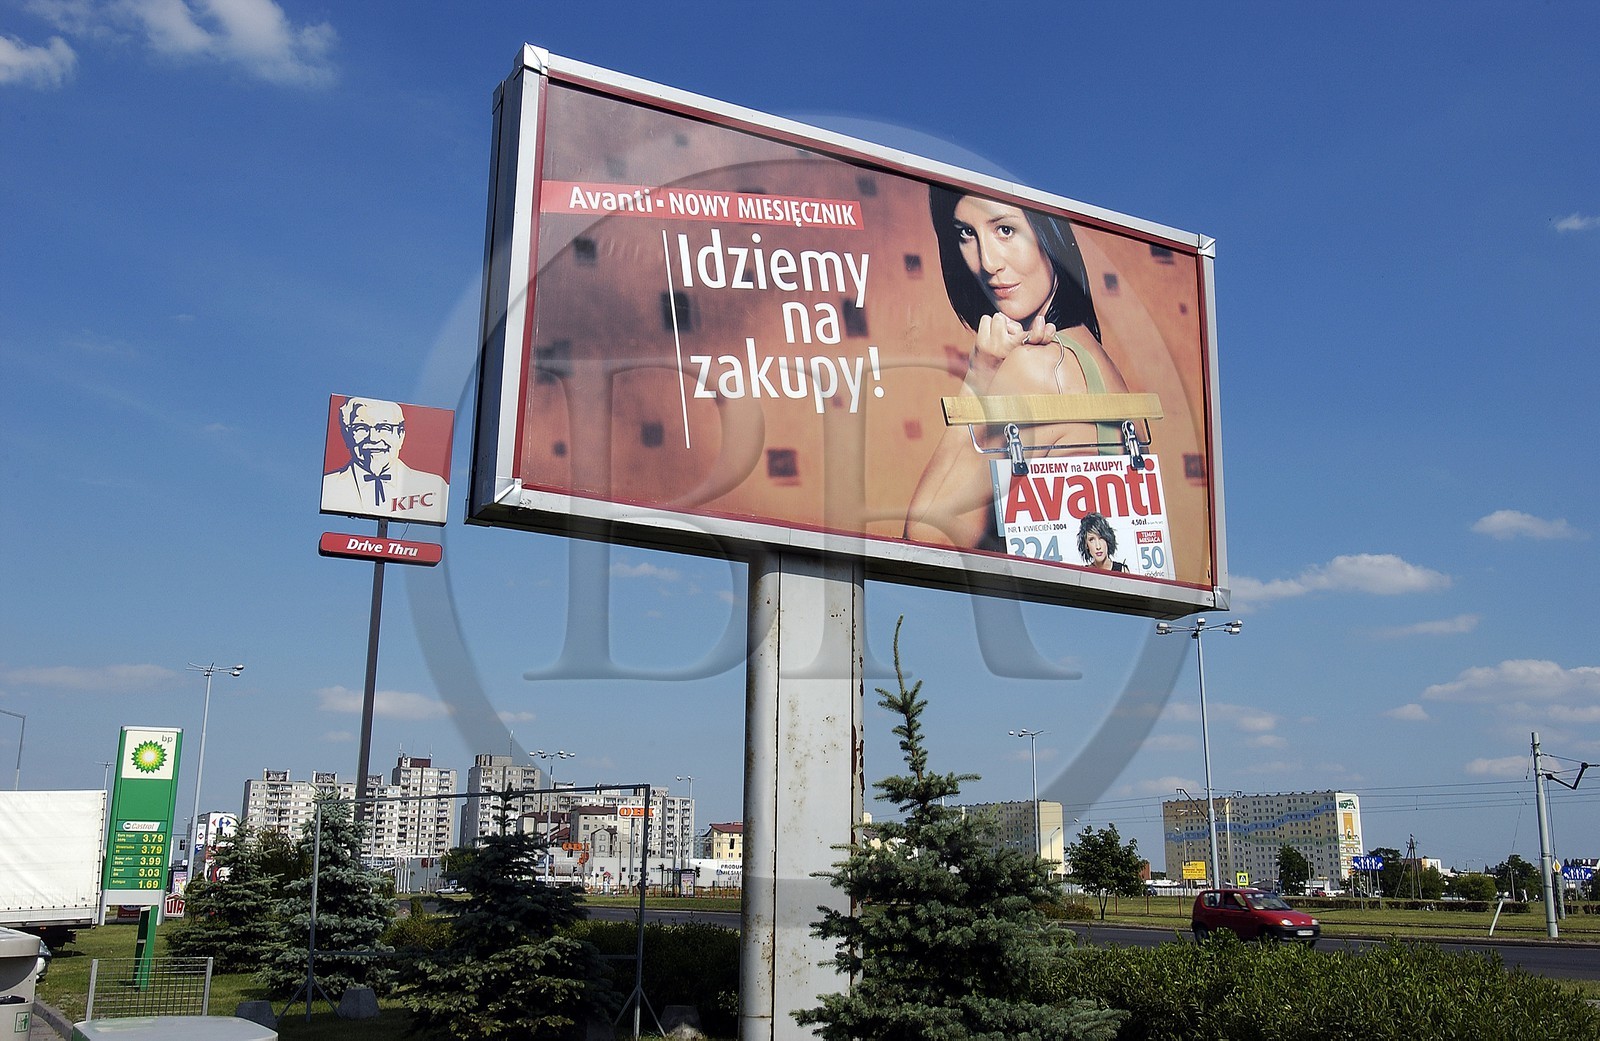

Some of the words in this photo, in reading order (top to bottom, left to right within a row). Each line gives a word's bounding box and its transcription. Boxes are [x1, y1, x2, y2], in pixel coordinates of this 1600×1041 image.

[568, 185, 654, 213] Avanti
[668, 191, 731, 218] NOWY
[737, 196, 857, 228] MIESIĘCZNIK
[677, 228, 870, 309] Idziemy
[782, 301, 842, 344] na
[690, 337, 885, 414] zakupy!
[1030, 462, 1069, 475] IDZIEMY
[1071, 463, 1082, 473] na
[1083, 460, 1123, 472] ZAKUPY!
[1004, 458, 1162, 524] Avanti
[390, 492, 434, 513] KFC
[1053, 523, 1067, 531] 2004
[346, 538, 384, 554] Drive
[387, 542, 419, 557] Thru
[1140, 545, 1165, 570] 50
[161, 734, 174, 743] bp
[142, 834, 164, 843] 3.79
[141, 845, 163, 854] 3.79
[140, 857, 161, 866] 3.99
[138, 868, 160, 877] 3.03
[138, 880, 159, 889] 1.69
